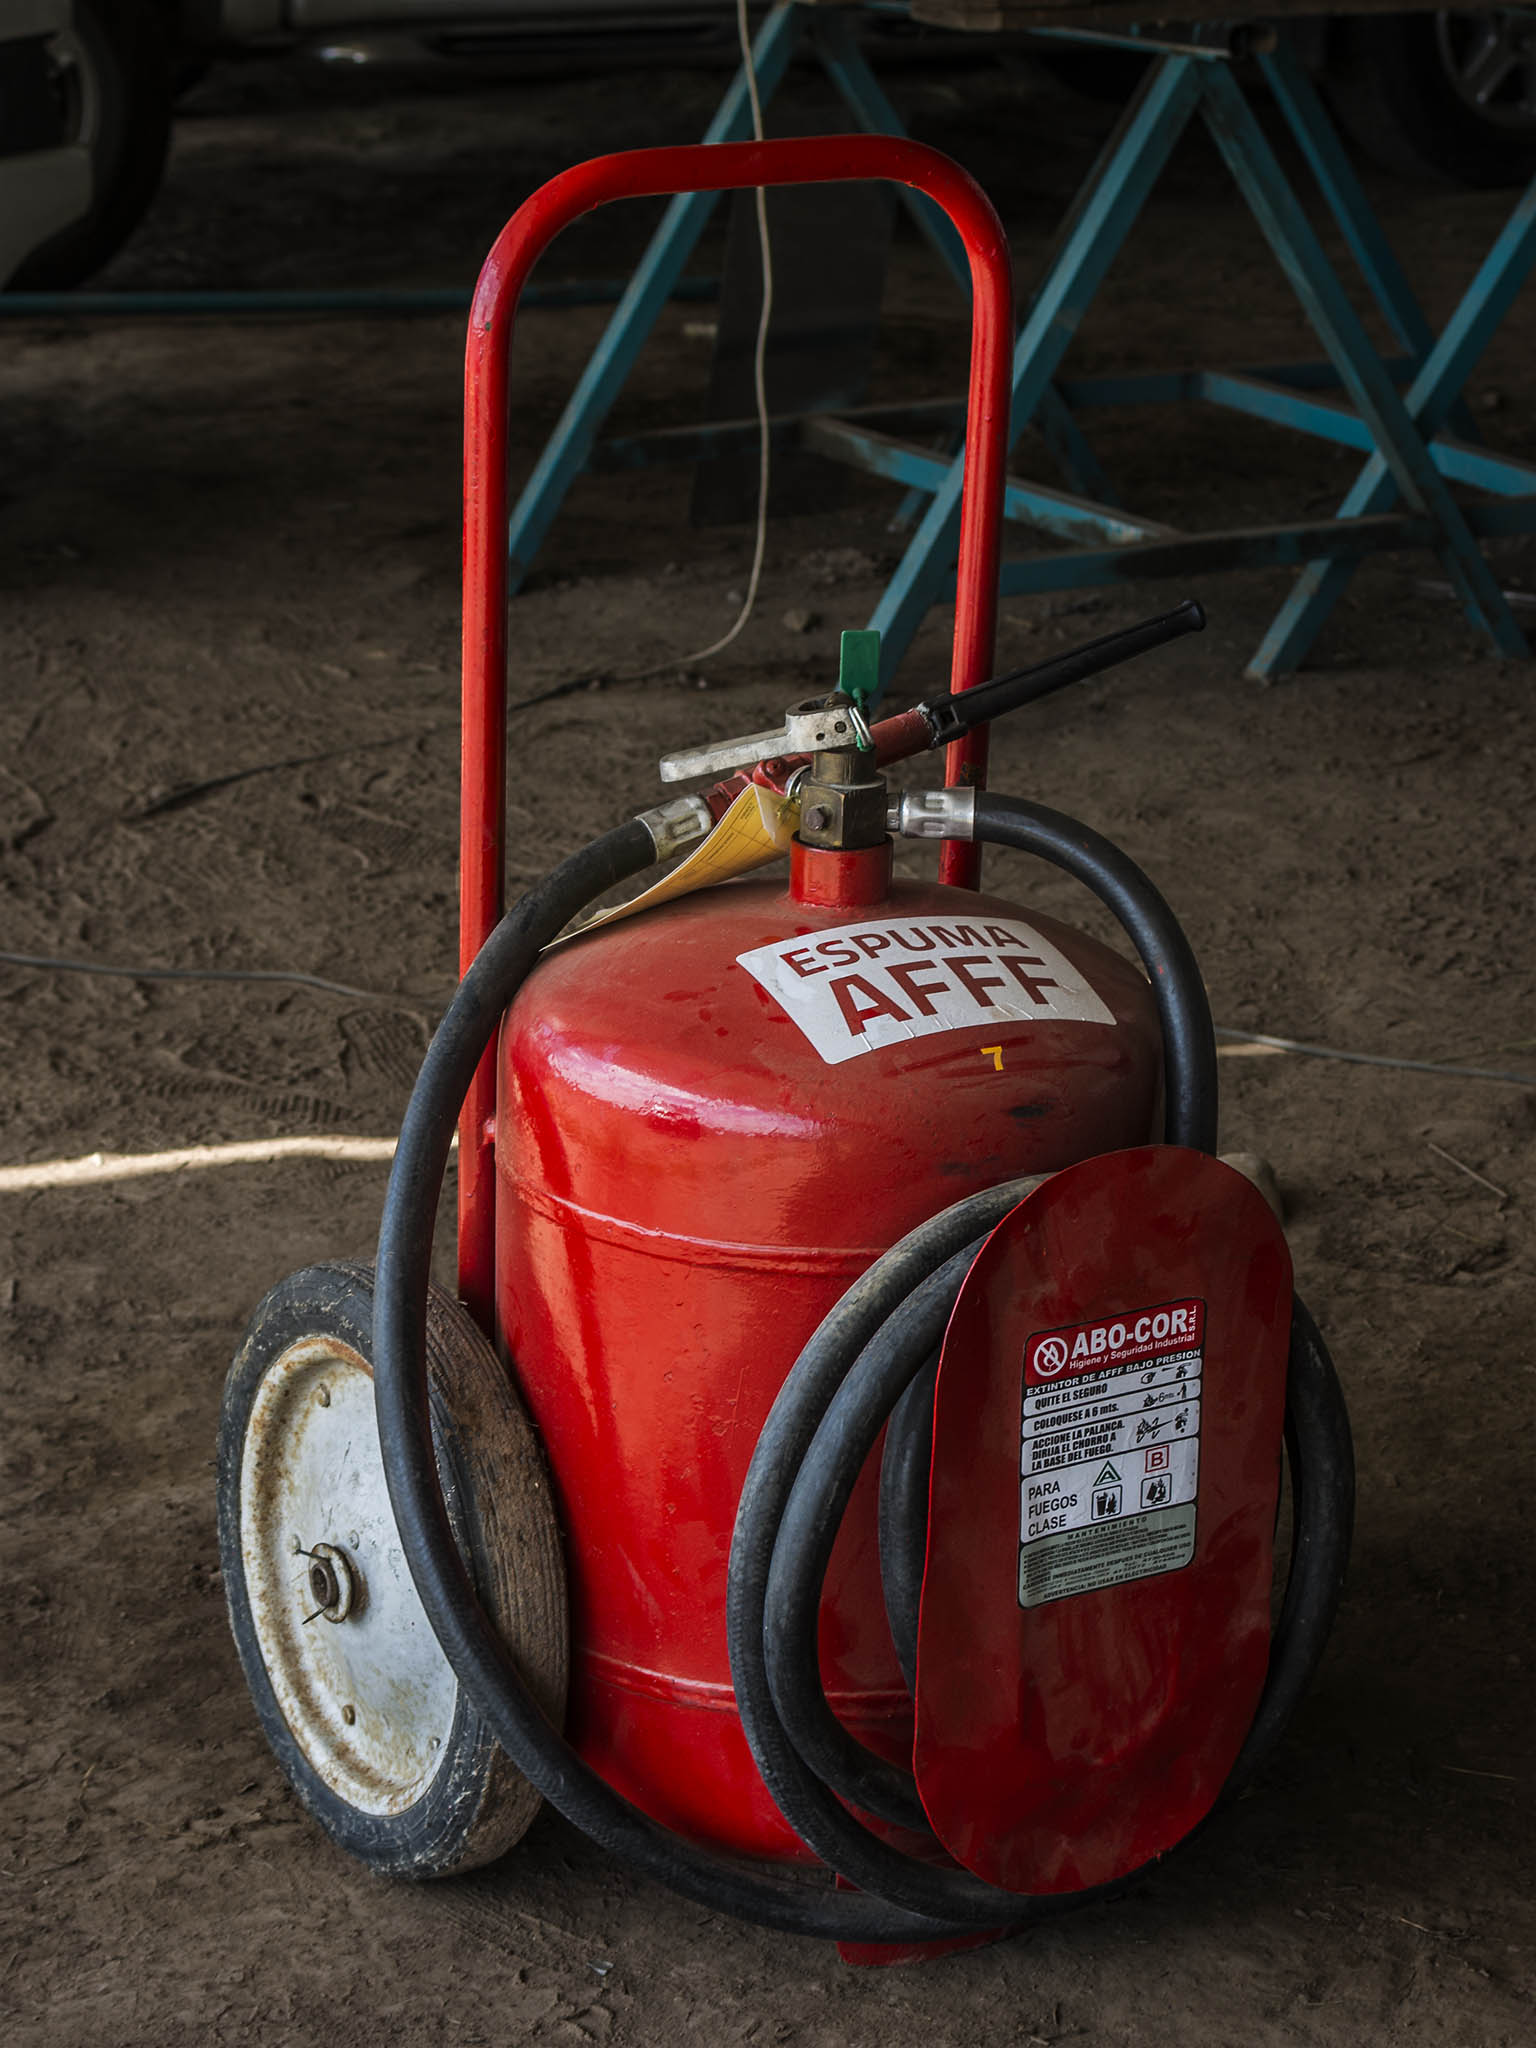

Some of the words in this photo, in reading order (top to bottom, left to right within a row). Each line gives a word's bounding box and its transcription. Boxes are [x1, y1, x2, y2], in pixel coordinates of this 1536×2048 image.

[780, 925, 1029, 978] ESPUMA
[829, 955, 1060, 1036] AFFF
[980, 1046, 1004, 1071] 7
[1071, 1308, 1188, 1359] ABO-COR
[1069, 1356, 1101, 1370] Higiene
[1103, 1354, 1108, 1363] y
[1111, 1344, 1153, 1360] Seguridad
[1155, 1333, 1195, 1349] Industrial
[1026, 1375, 1080, 1396] EXTINTOR
[1082, 1373, 1095, 1383] DE
[1098, 1366, 1124, 1380] AFFF
[1126, 1361, 1153, 1373] BAJO
[1155, 1349, 1201, 1366] PRESION
[1035, 1393, 1061, 1410] QUITE
[1062, 1390, 1071, 1402] EL
[1073, 1383, 1108, 1400] SEGURO
[1034, 1410, 1083, 1431] COLOQUESE
[1084, 1408, 1090, 1418] A
[1092, 1407, 1097, 1417] 6
[1100, 1404, 1119, 1415] mts.
[1032, 1432, 1071, 1450] ACCIONE
[1072, 1429, 1082, 1440] LA
[1084, 1420, 1125, 1437] PALANCA.
[1032, 1447, 1060, 1460] DIRIJA
[1062, 1443, 1070, 1453] EL
[1073, 1435, 1108, 1449] CHORRO
[1110, 1432, 1116, 1441] A
[1032, 1460, 1041, 1471] LA
[1044, 1455, 1066, 1468] BASE
[1068, 1451, 1082, 1462] DEL
[1084, 1444, 1113, 1457] FUEGO.
[1151, 1452, 1162, 1467] B
[1100, 1470, 1116, 1483] A
[1028, 1481, 1061, 1501] PARA
[1029, 1494, 1077, 1519] FUEGOS
[1028, 1515, 1067, 1537] CLASE
